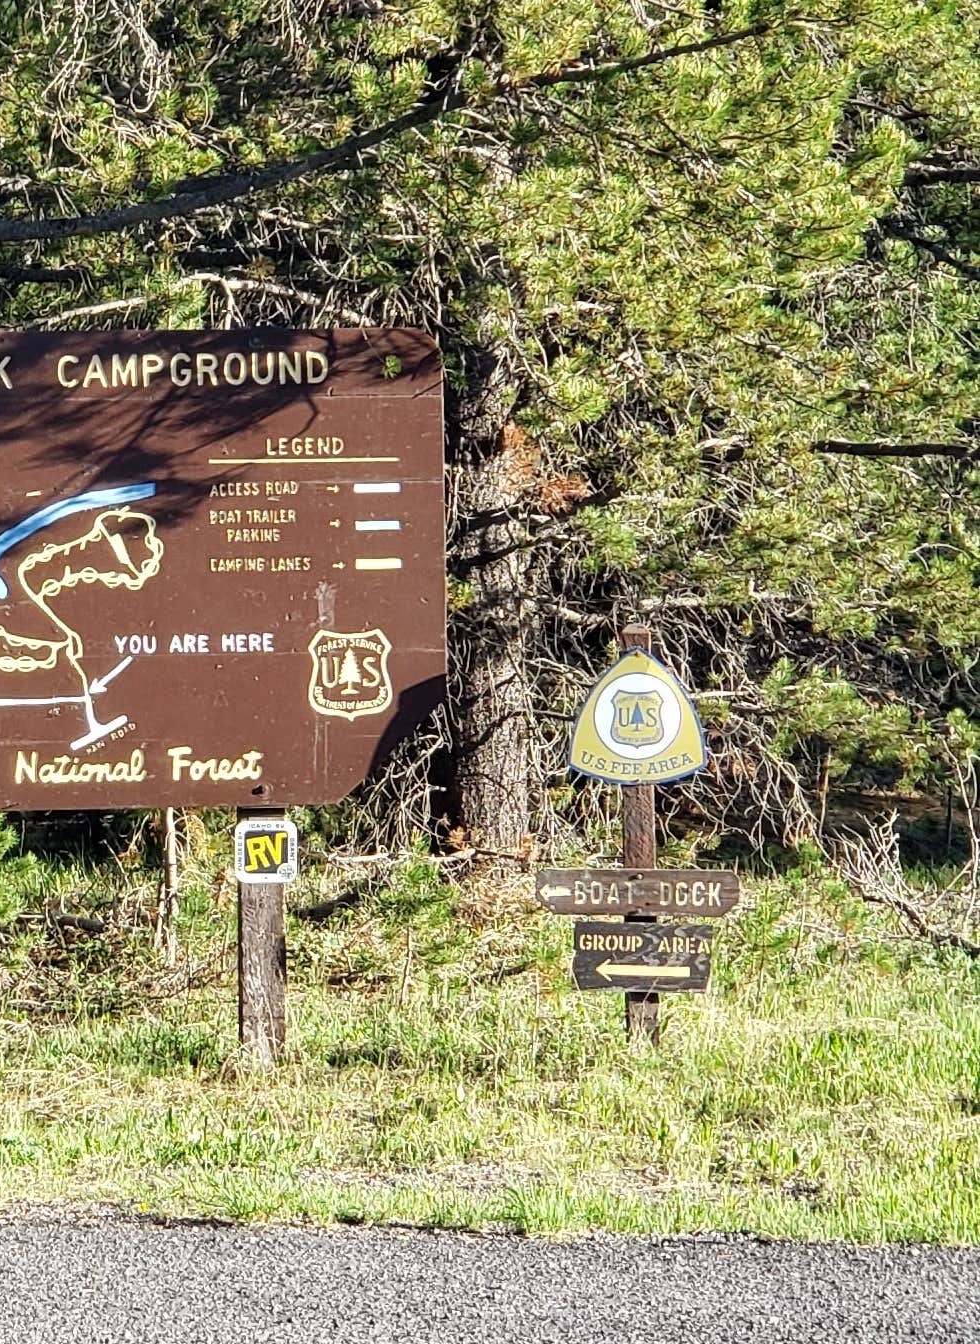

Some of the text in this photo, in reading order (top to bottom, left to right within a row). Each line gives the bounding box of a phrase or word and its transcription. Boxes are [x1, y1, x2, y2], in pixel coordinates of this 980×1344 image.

[56, 350, 329, 389] CAMPGROUND
[266, 437, 345, 456] LEGEND
[209, 480, 300, 498] ACCESS ROAD
[209, 509, 296, 525] BOAT TRAILER
[226, 528, 281, 543] PARKING
[210, 557, 311, 572] CAMPING LANES
[114, 632, 275, 654] YOU ARE HERE
[14, 748, 148, 785] National
[167, 746, 263, 782] Forest
[610, 761, 643, 775] FEE
[646, 753, 694, 775] AREA
[244, 832, 288, 872] RV
[574, 880, 722, 907] BOAT DOCK
[579, 934, 711, 955] GROUP AREA
